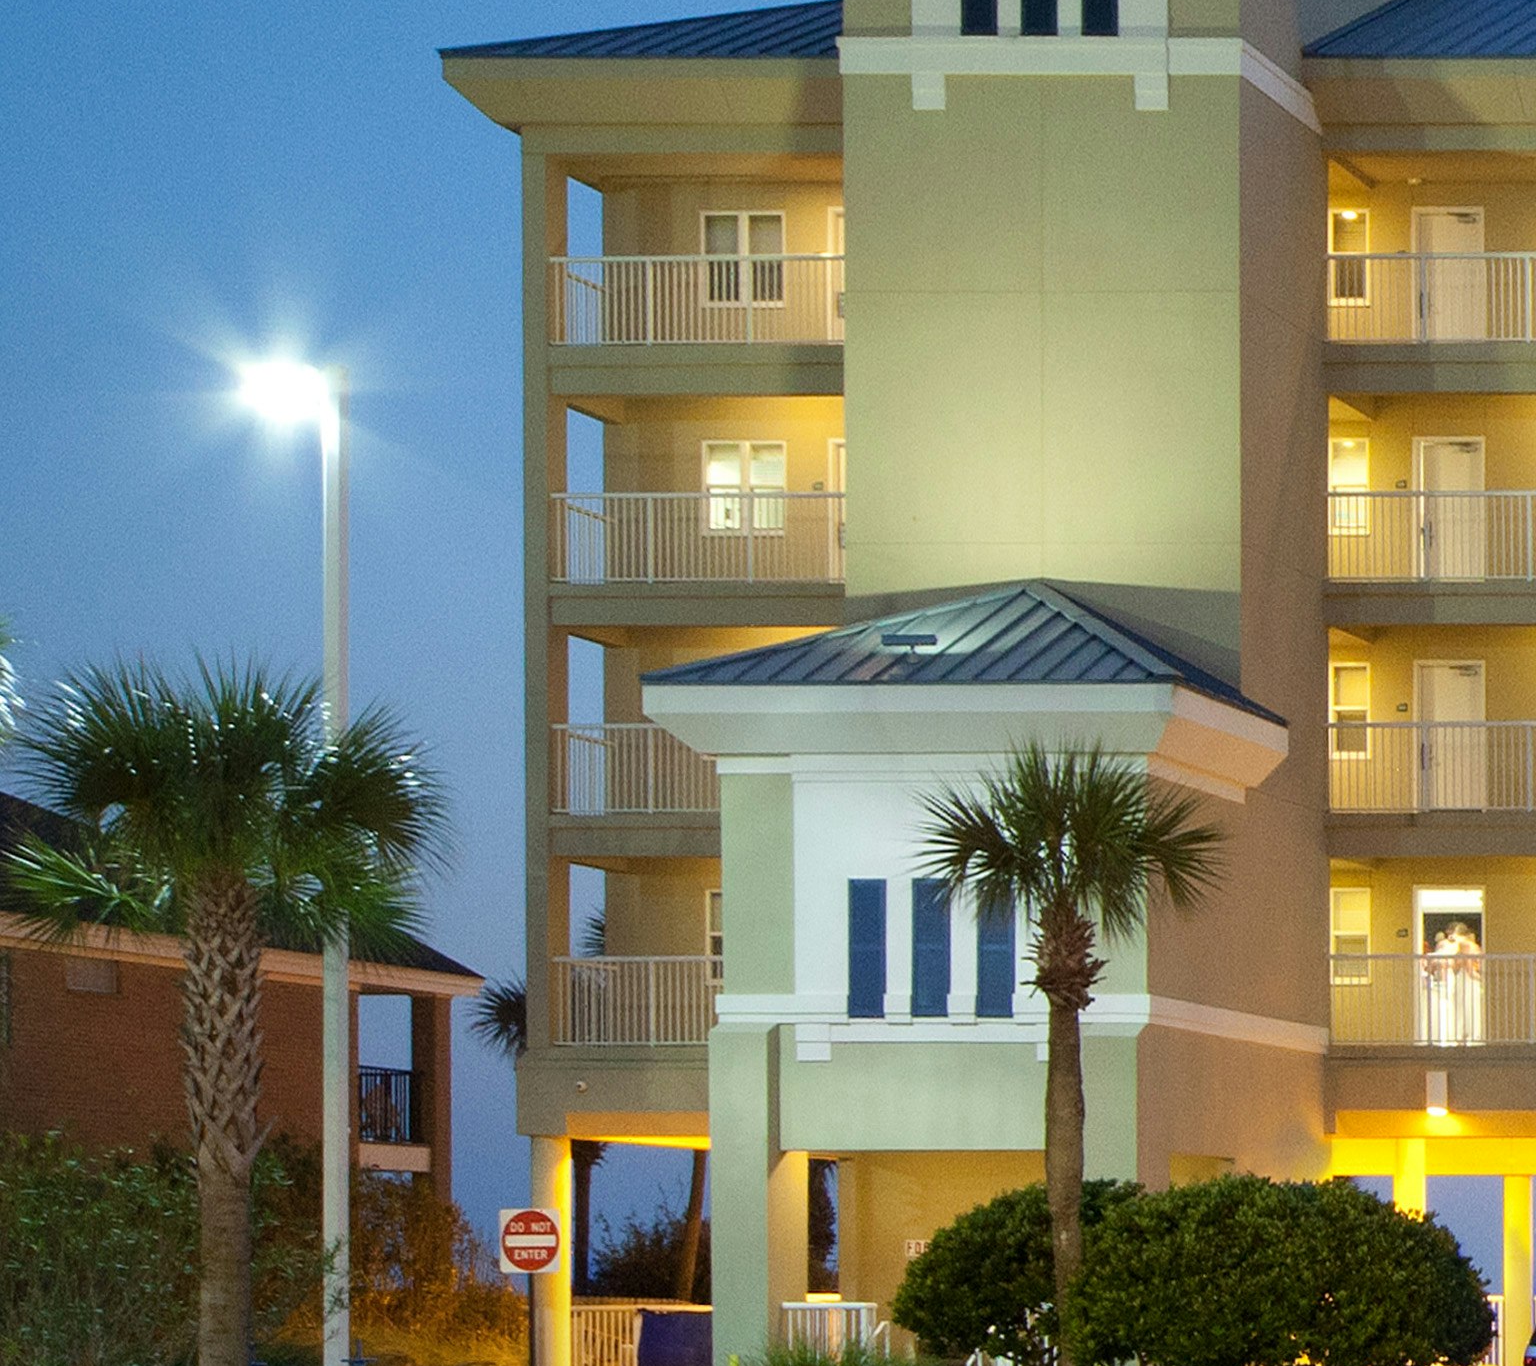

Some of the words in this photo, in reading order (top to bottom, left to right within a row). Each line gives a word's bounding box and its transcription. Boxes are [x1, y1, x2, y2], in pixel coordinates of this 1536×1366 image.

[510, 1221, 525, 1233] DO
[531, 1222, 551, 1233] NOT
[514, 1249, 548, 1260] ENTER
